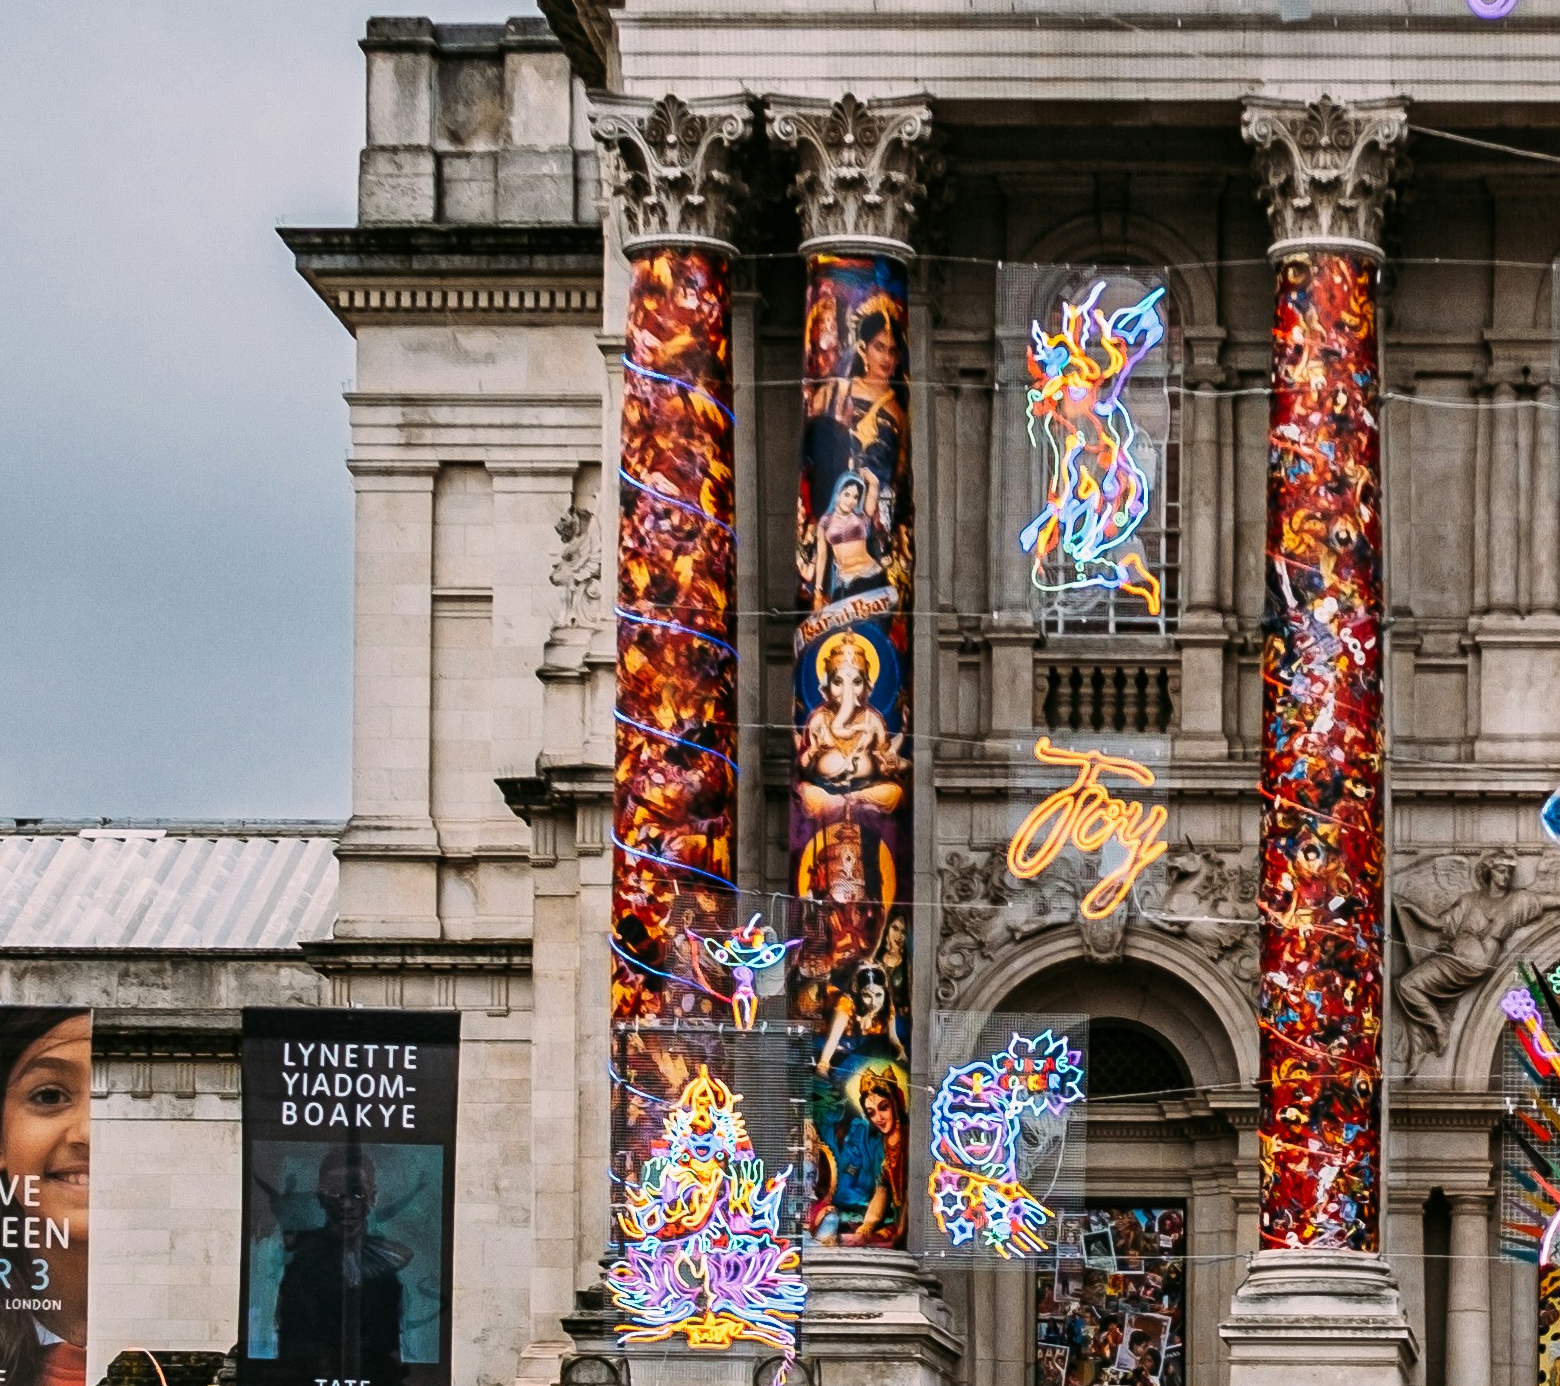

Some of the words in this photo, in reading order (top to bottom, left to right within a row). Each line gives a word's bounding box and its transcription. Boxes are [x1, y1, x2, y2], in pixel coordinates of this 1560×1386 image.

[1006, 735, 1169, 921] Joy
[283, 1042, 418, 1069] LYNETTE
[282, 1072, 417, 1099] YIADOM-
[282, 1101, 416, 1129] BOAKYE
[30, 1259, 50, 1291] 3
[5, 1299, 62, 1311] LONDON
